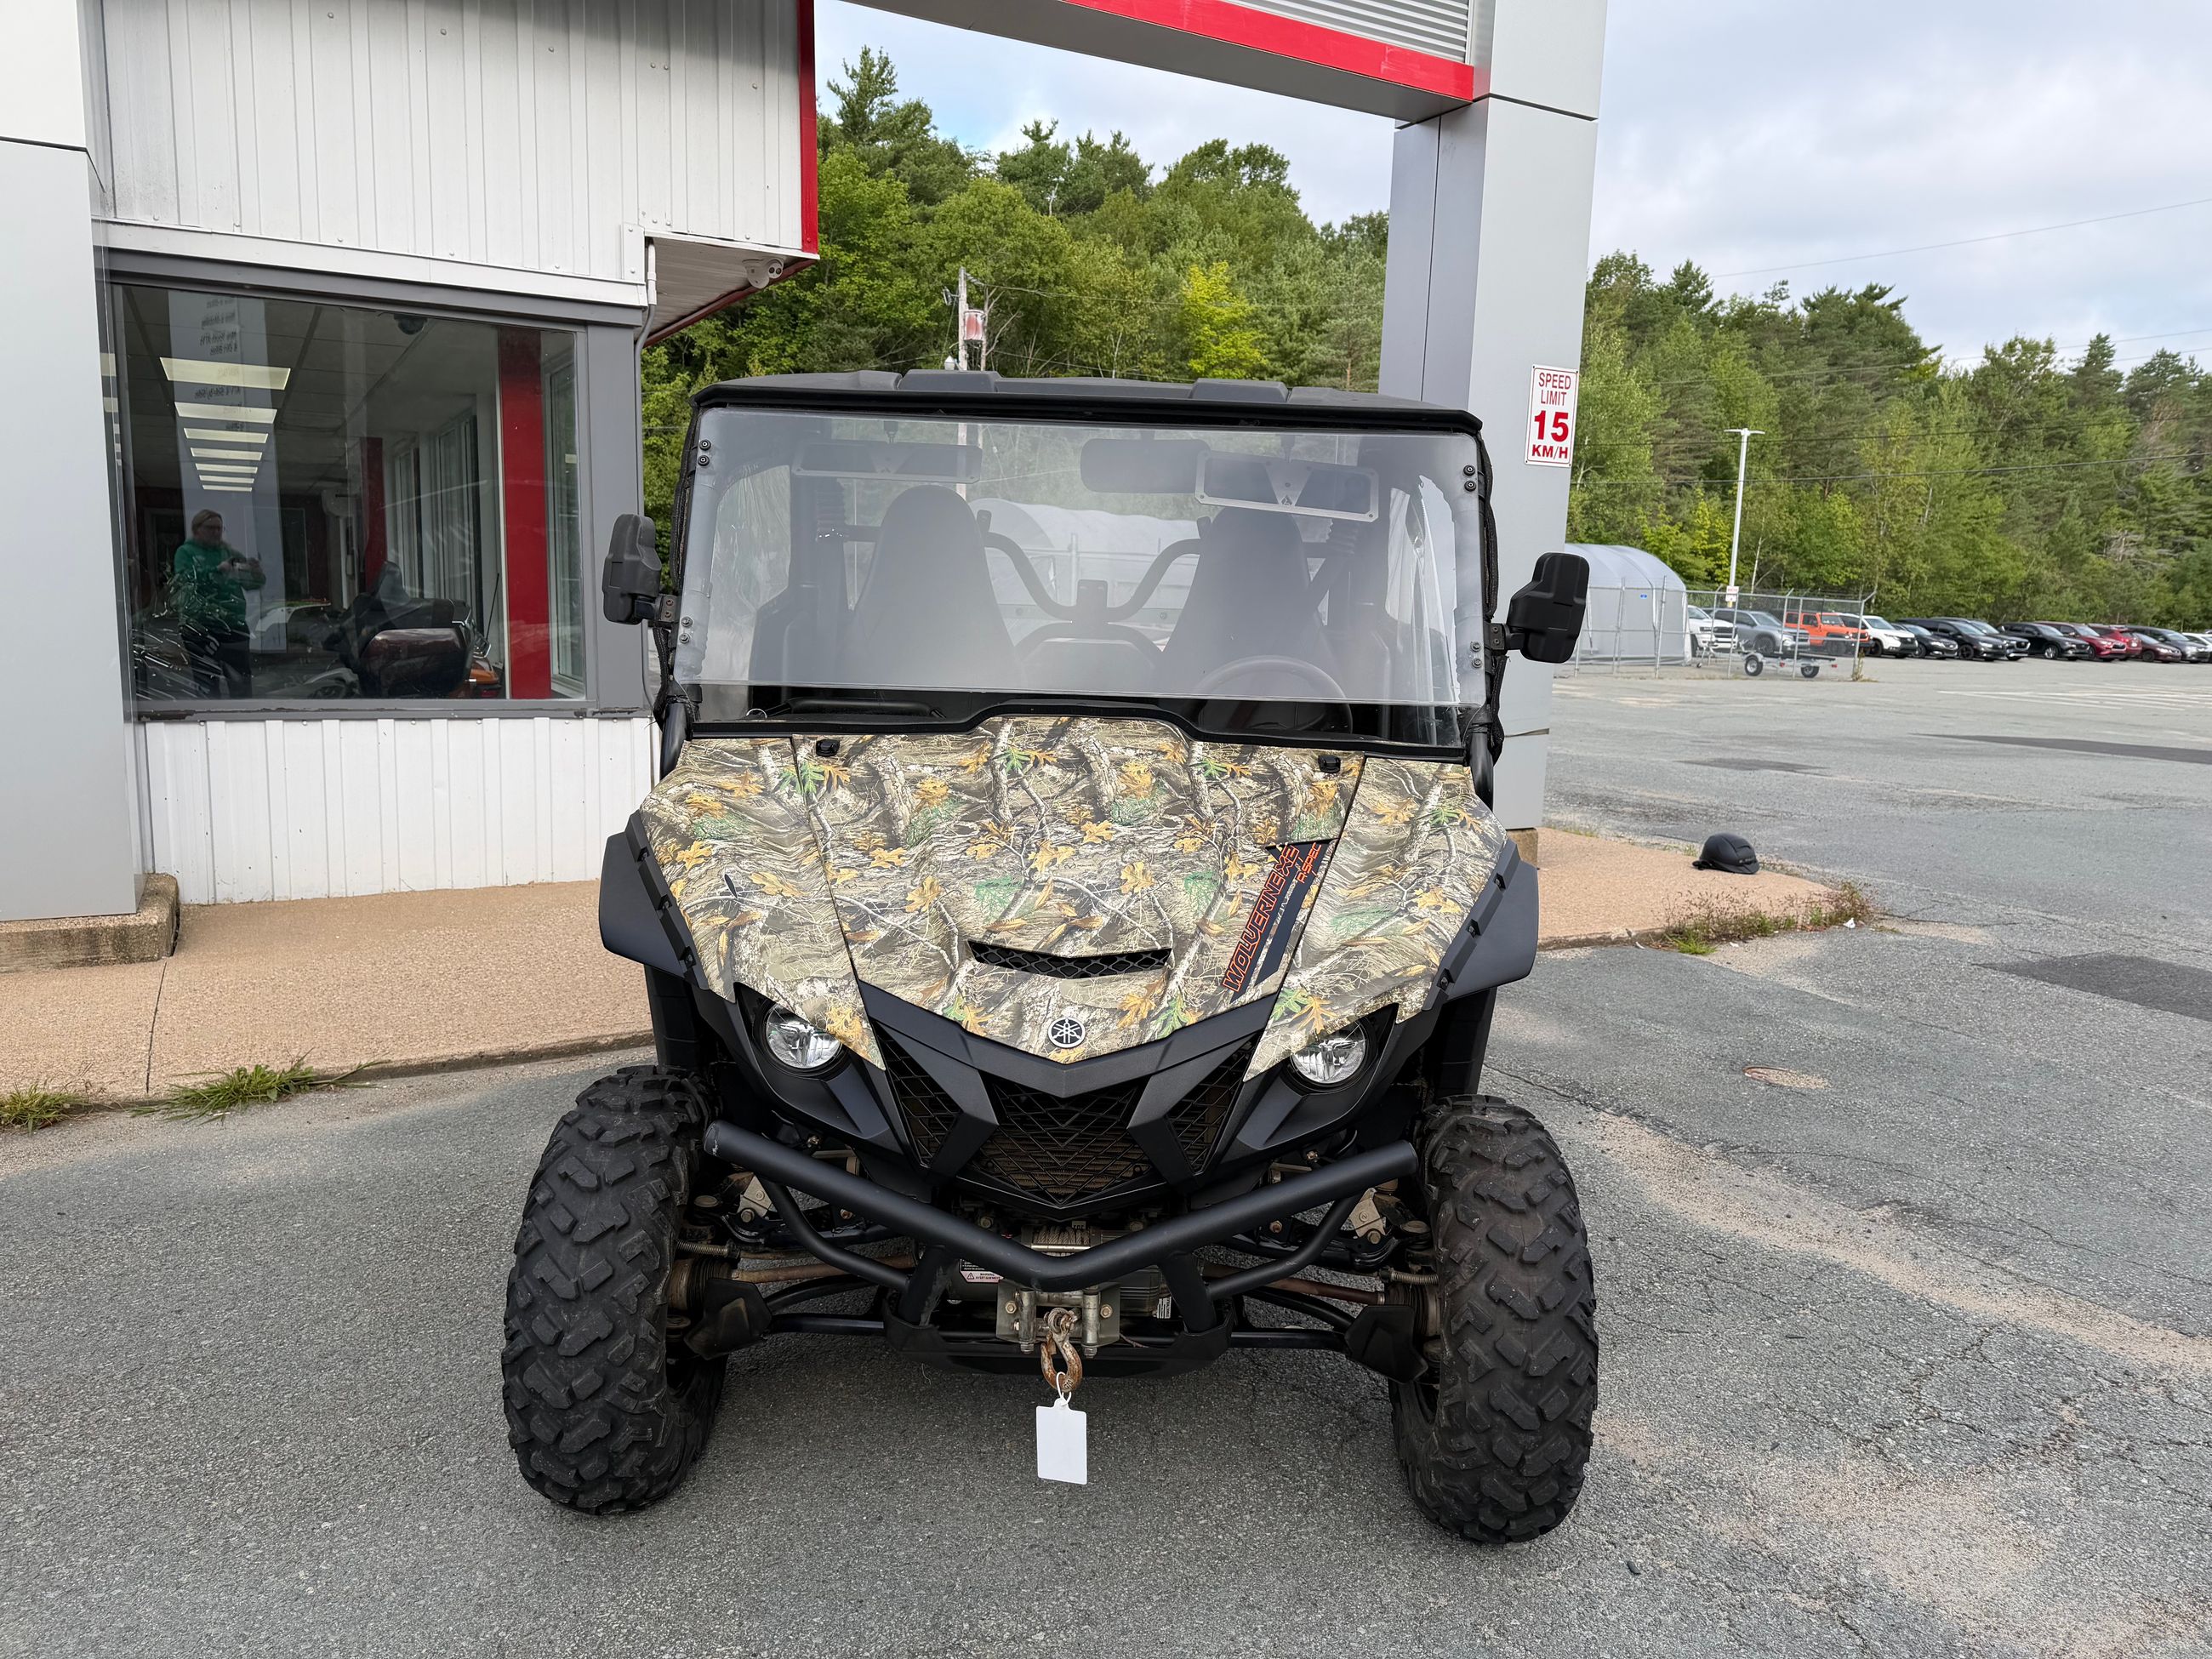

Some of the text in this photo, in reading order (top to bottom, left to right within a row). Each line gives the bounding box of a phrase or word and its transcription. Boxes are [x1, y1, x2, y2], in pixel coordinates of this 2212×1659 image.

[1538, 372, 1571, 390] SPEED
[1540, 390, 1567, 407] LIMIT
[1534, 410, 1569, 442] 15
[1531, 444, 1569, 459] KM/H
[1222, 843, 1300, 992] WOLVERINE X2
